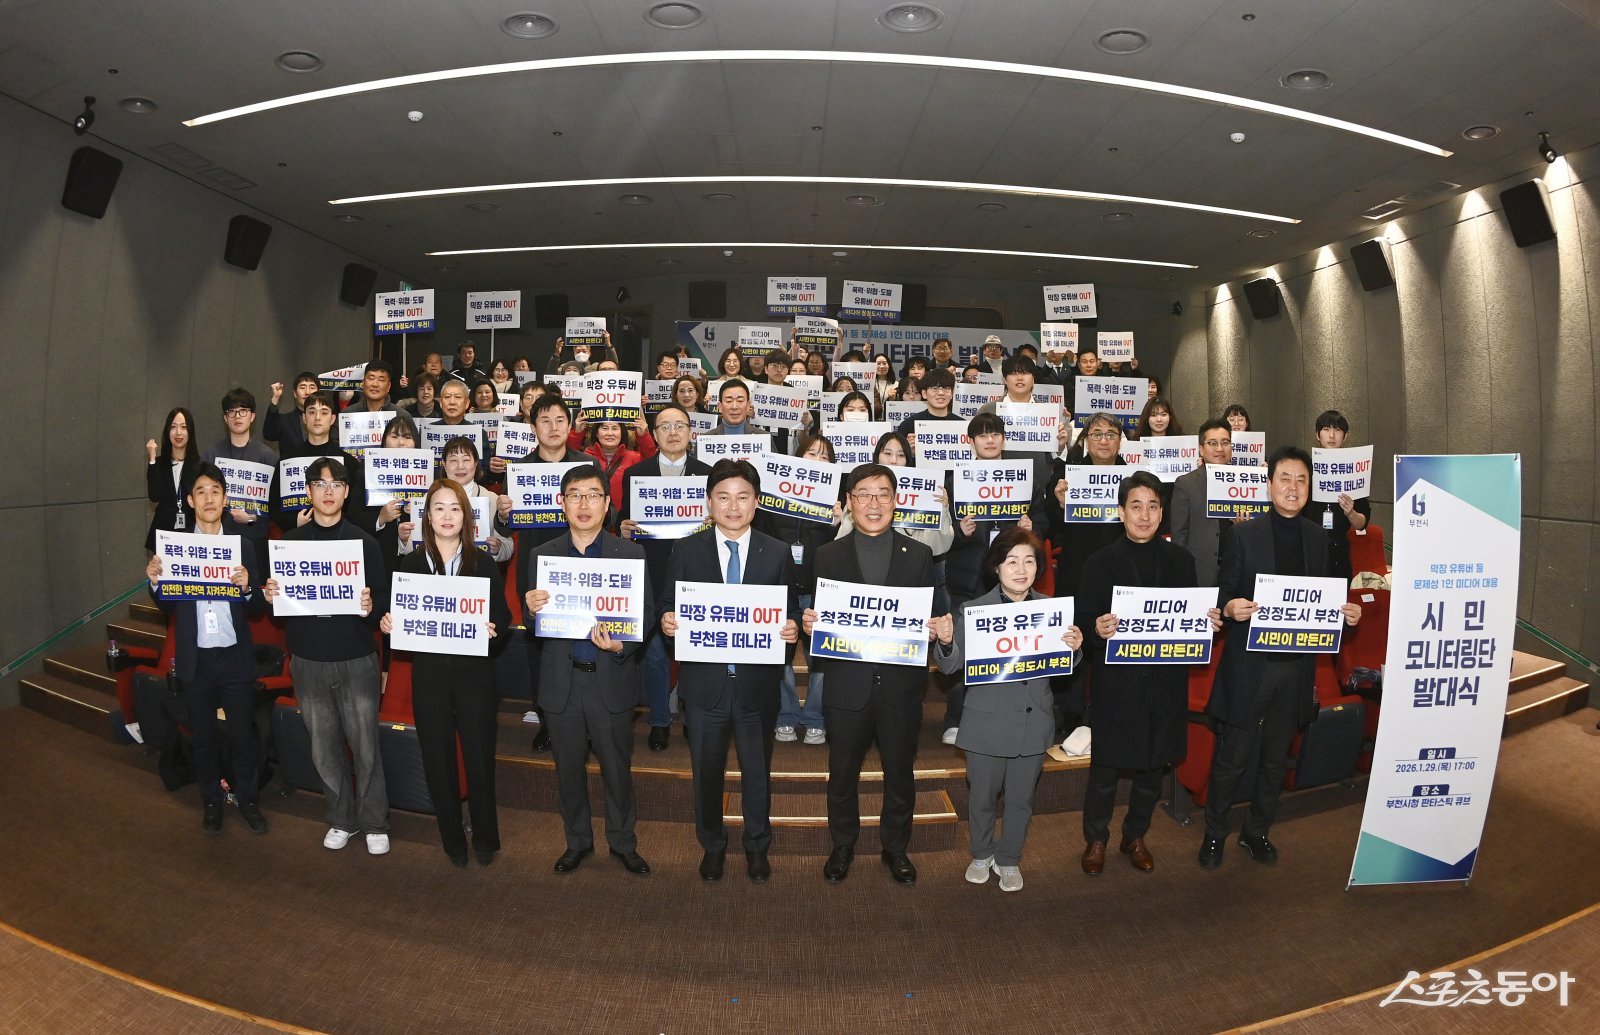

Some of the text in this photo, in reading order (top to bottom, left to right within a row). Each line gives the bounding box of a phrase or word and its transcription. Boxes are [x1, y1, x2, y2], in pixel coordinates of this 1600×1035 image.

[798, 294, 816, 302] OUT!
[1060, 292, 1092, 301] 유튜버 OUT
[484, 300, 517, 309] 유튜버 OUT
[873, 299, 890, 308] OUT!
[406, 308, 423, 317] OUT!
[494, 314, 512, 322] 떠나라
[332, 370, 354, 378] OUT
[586, 380, 637, 390] 막장 유튜버
[1086, 384, 1137, 395] 폭력·위협·도발
[596, 393, 626, 404] OUT
[754, 394, 768, 404] 막장
[769, 396, 790, 406] 유튜버
[790, 398, 805, 408] OUT
[970, 394, 988, 403] 유튜버
[1050, 395, 1062, 404] OUT
[1090, 398, 1134, 410] 유튜버 OUT!
[606, 408, 640, 418] 감시한다!
[757, 408, 799, 421] 부천을 떠나라
[888, 412, 902, 421] 막장
[1040, 416, 1056, 426] OUT
[845, 435, 868, 446] 유튜버
[918, 434, 958, 444] 막장 유튜버
[1028, 432, 1051, 442] 떠나라
[506, 444, 528, 456] 유튜버
[706, 442, 762, 454] 막장 유튜버
[1158, 448, 1196, 459] 유튜버 OUT
[1250, 444, 1263, 452] OUT
[924, 450, 972, 460] 부천을 떠나라
[1126, 454, 1142, 464] OUT
[372, 458, 428, 470] 폭력·위협·도발
[1238, 457, 1258, 466] 떠나라
[1314, 460, 1370, 475] 막장 유튜버 OUT
[766, 462, 833, 486] 막장 유튜버
[1170, 464, 1192, 473] 떠나라
[378, 475, 426, 486] 유튜버 OUT!
[992, 468, 1026, 482] 유튜버
[1089, 474, 1122, 485] 미디어
[1214, 472, 1236, 483] 막장
[778, 482, 816, 498] OUT
[898, 476, 936, 492] 유튜버
[1318, 478, 1365, 492] 부천을 떠나라
[246, 486, 266, 498] OUT!
[638, 488, 706, 500] 폭력·위협·도발
[978, 486, 1014, 499] OUT
[1070, 488, 1114, 500] 청정도시
[1228, 487, 1258, 498] OUT
[522, 493, 552, 506] 유튜버
[644, 505, 703, 518] 유튜버 OUT!
[957, 505, 987, 516] 시민이
[1072, 508, 1101, 518] 시민이
[1209, 504, 1230, 512] 미디어
[1232, 504, 1260, 513] 청정도시
[512, 512, 534, 524] 안전한
[535, 512, 556, 524] 부천역
[894, 512, 939, 525] 감시한다!
[1408, 520, 1428, 528] 부천시
[164, 544, 232, 560] 폭력·위협·도발
[171, 564, 230, 579] 유튜버 OUT!
[274, 560, 360, 576] 막장 유튜버 OUT
[1430, 562, 1484, 574] 막장 유튜버 등
[548, 571, 632, 588] 폭력·위협·도발
[1414, 578, 1498, 590] 문제성 1인 미디어 대응
[162, 584, 240, 598] 안전한 부천역 지켜주세요
[284, 584, 354, 600] 부천을 떠나라
[1282, 588, 1322, 604] 미디어
[395, 593, 486, 615] 막장 유튜버 OUT
[554, 594, 628, 612] 유튜버 OUT!
[850, 596, 900, 612] 미디어
[1143, 600, 1188, 614] 미디어
[680, 604, 782, 624] 막장 유튜버 OUT
[1257, 606, 1340, 623] 청정도시 부천
[820, 610, 924, 633] 청정도시 부천
[976, 611, 1063, 634] 막장 유튜버
[1180, 618, 1208, 633] 부천
[403, 619, 477, 640] 부천을 떠나라
[689, 630, 772, 650] 부천을 떠나라
[820, 636, 864, 654] 시민이
[996, 634, 1044, 654] OUT
[1256, 632, 1334, 647] 시민이 만든다!
[1116, 644, 1204, 658] 시민이 만든다!
[1405, 638, 1496, 670] 모니터링단
[968, 656, 1070, 676] 미디어 청정도시 부천
[1412, 676, 1480, 708] 발대식
[1395, 761, 1475, 772] 2026.1.29.(목) 17:00
[1386, 796, 1472, 808] 부천시청 판타스틱 큐브
